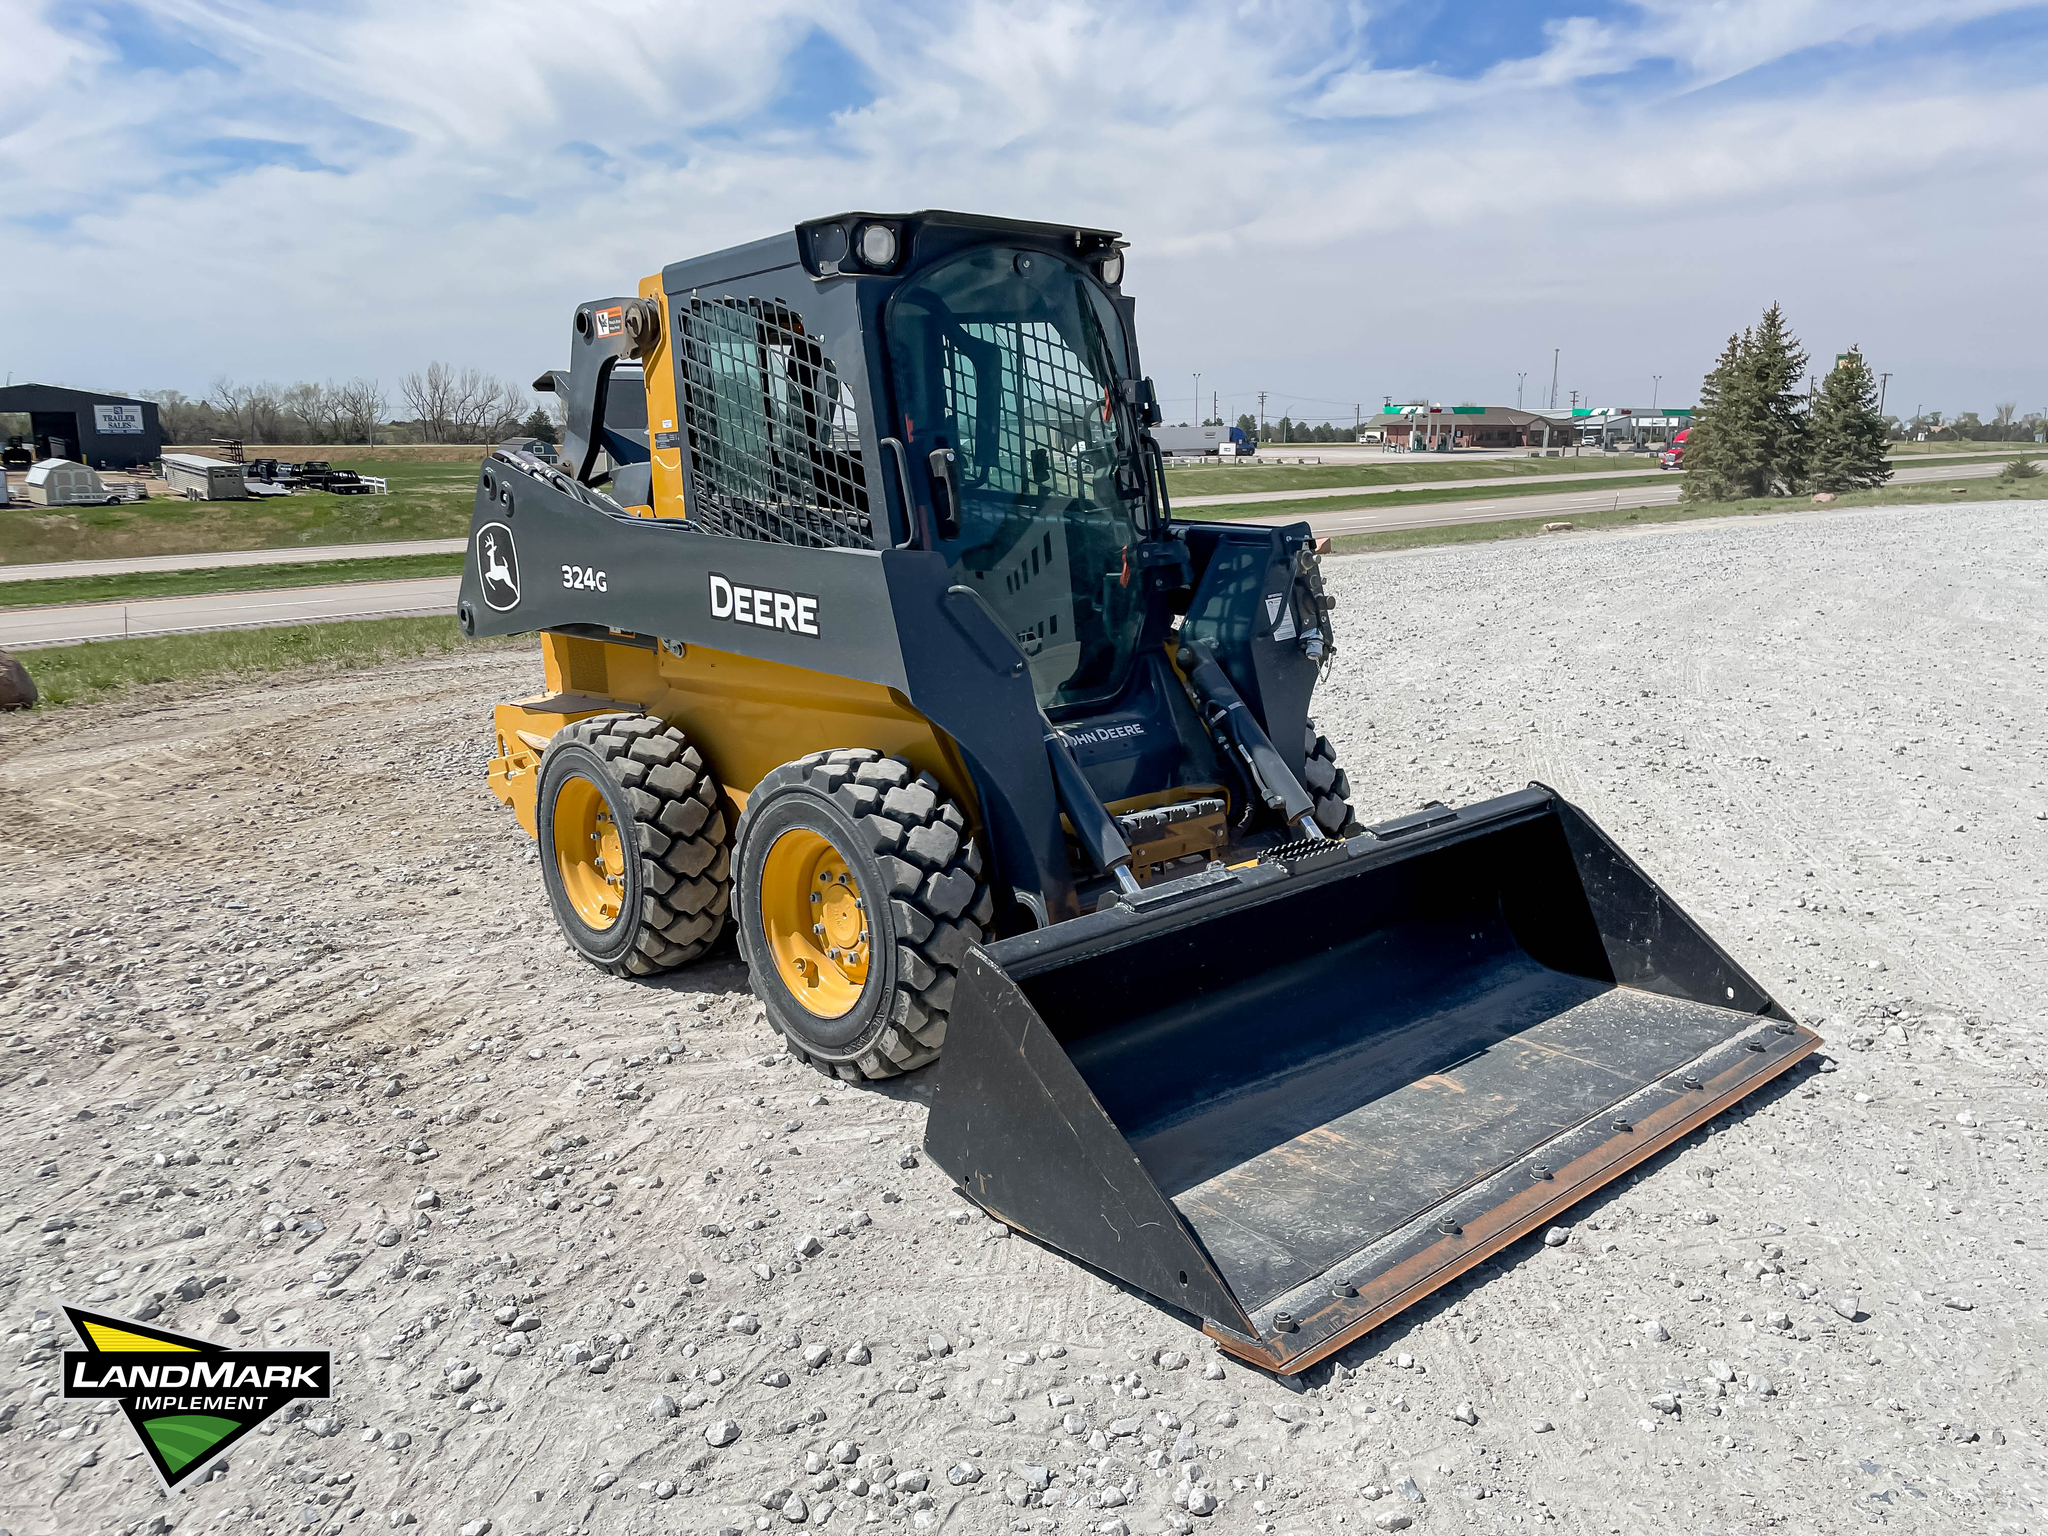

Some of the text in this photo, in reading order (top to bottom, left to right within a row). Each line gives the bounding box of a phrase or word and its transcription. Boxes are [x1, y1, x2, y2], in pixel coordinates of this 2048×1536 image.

[102, 414, 136, 422] TRAILER
[108, 421, 132, 429] SALES
[561, 564, 608, 593] 324G
[709, 573, 820, 637] DEERE
[1095, 723, 1144, 741] DEERE
